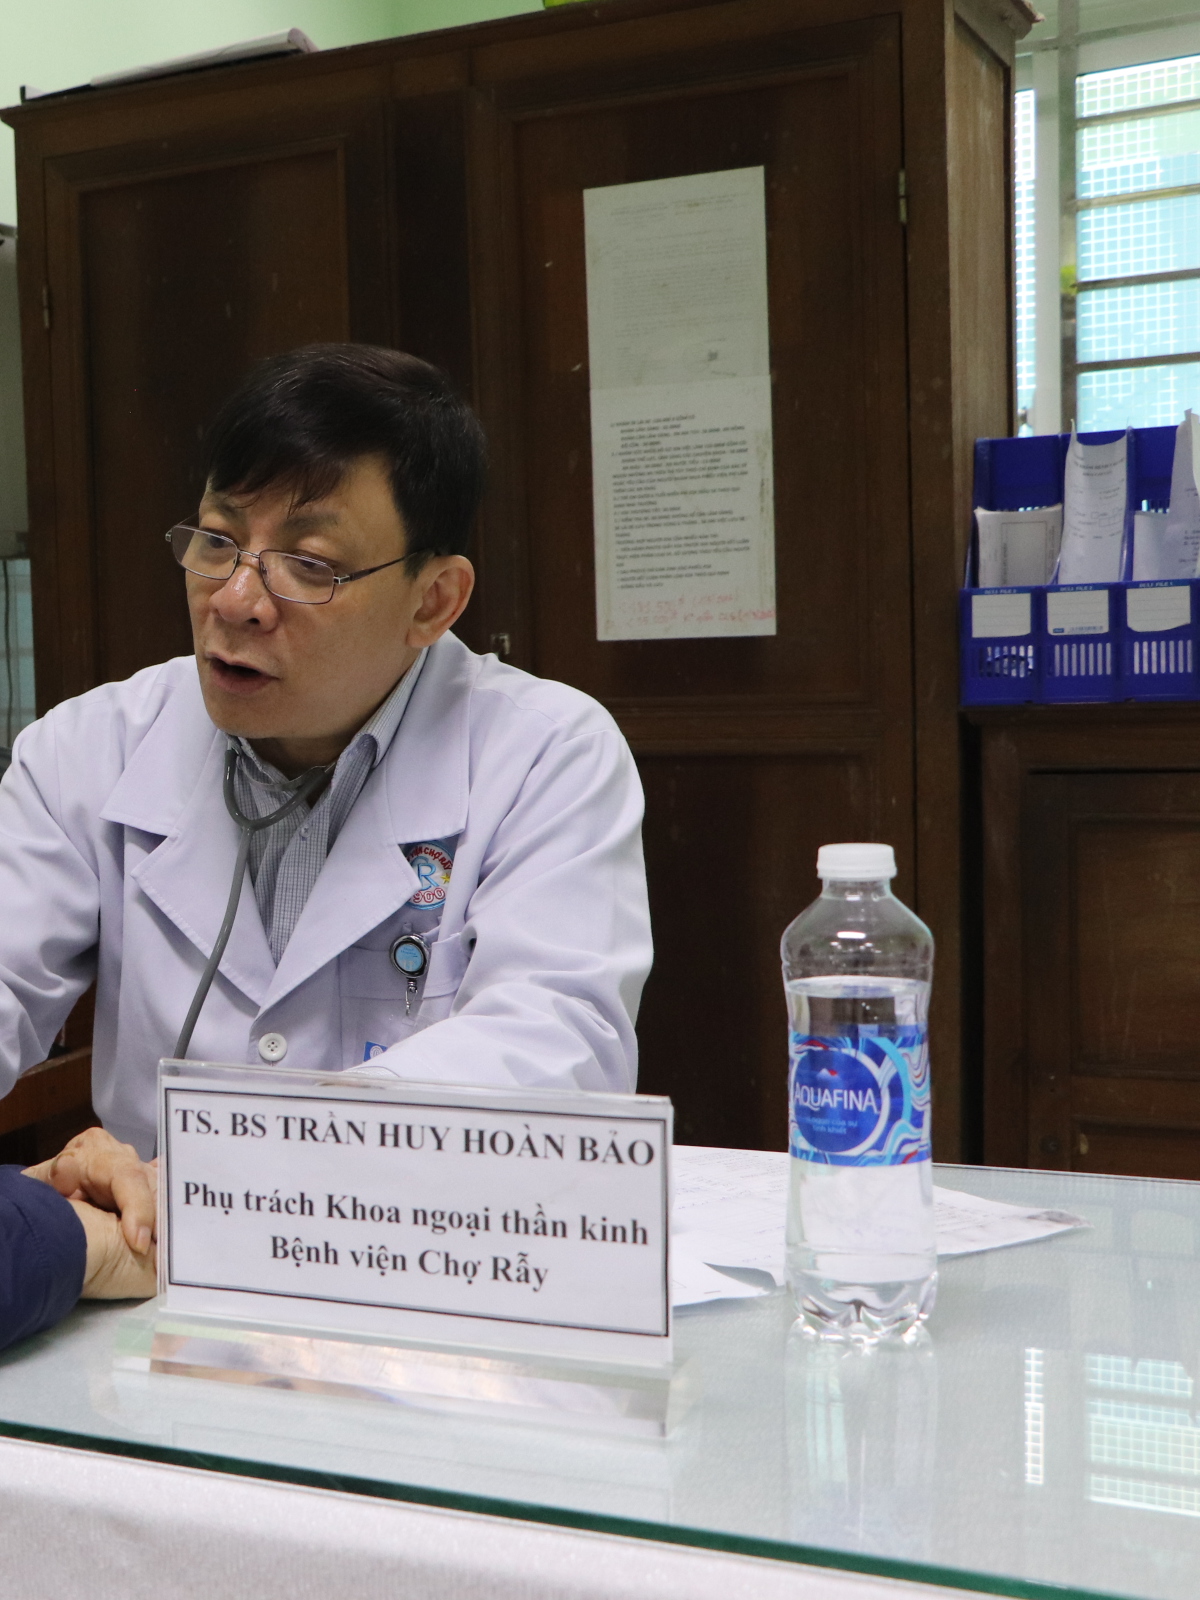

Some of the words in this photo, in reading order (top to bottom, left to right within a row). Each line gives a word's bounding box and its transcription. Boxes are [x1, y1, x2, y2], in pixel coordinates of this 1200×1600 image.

[424, 847, 443, 860] CHỢ
[413, 887, 445, 903] 900
[794, 1082, 878, 1114] AQUAFINA
[175, 1108, 221, 1136] TS.
[230, 1112, 267, 1138] BS
[276, 1109, 367, 1147] TRẦN
[378, 1122, 450, 1152] HUY
[463, 1122, 566, 1160] HOÀN
[578, 1127, 655, 1167] BẢO
[184, 1181, 234, 1215] Phụ
[244, 1187, 314, 1216] trách
[325, 1194, 401, 1224] Khoa
[413, 1202, 490, 1238] ngoại
[501, 1203, 567, 1238] thần
[580, 1214, 649, 1246] kinh
[271, 1235, 339, 1266] Bệnh
[350, 1245, 407, 1276] viện
[418, 1249, 481, 1283] Chợ
[491, 1252, 548, 1292] Rẫy
